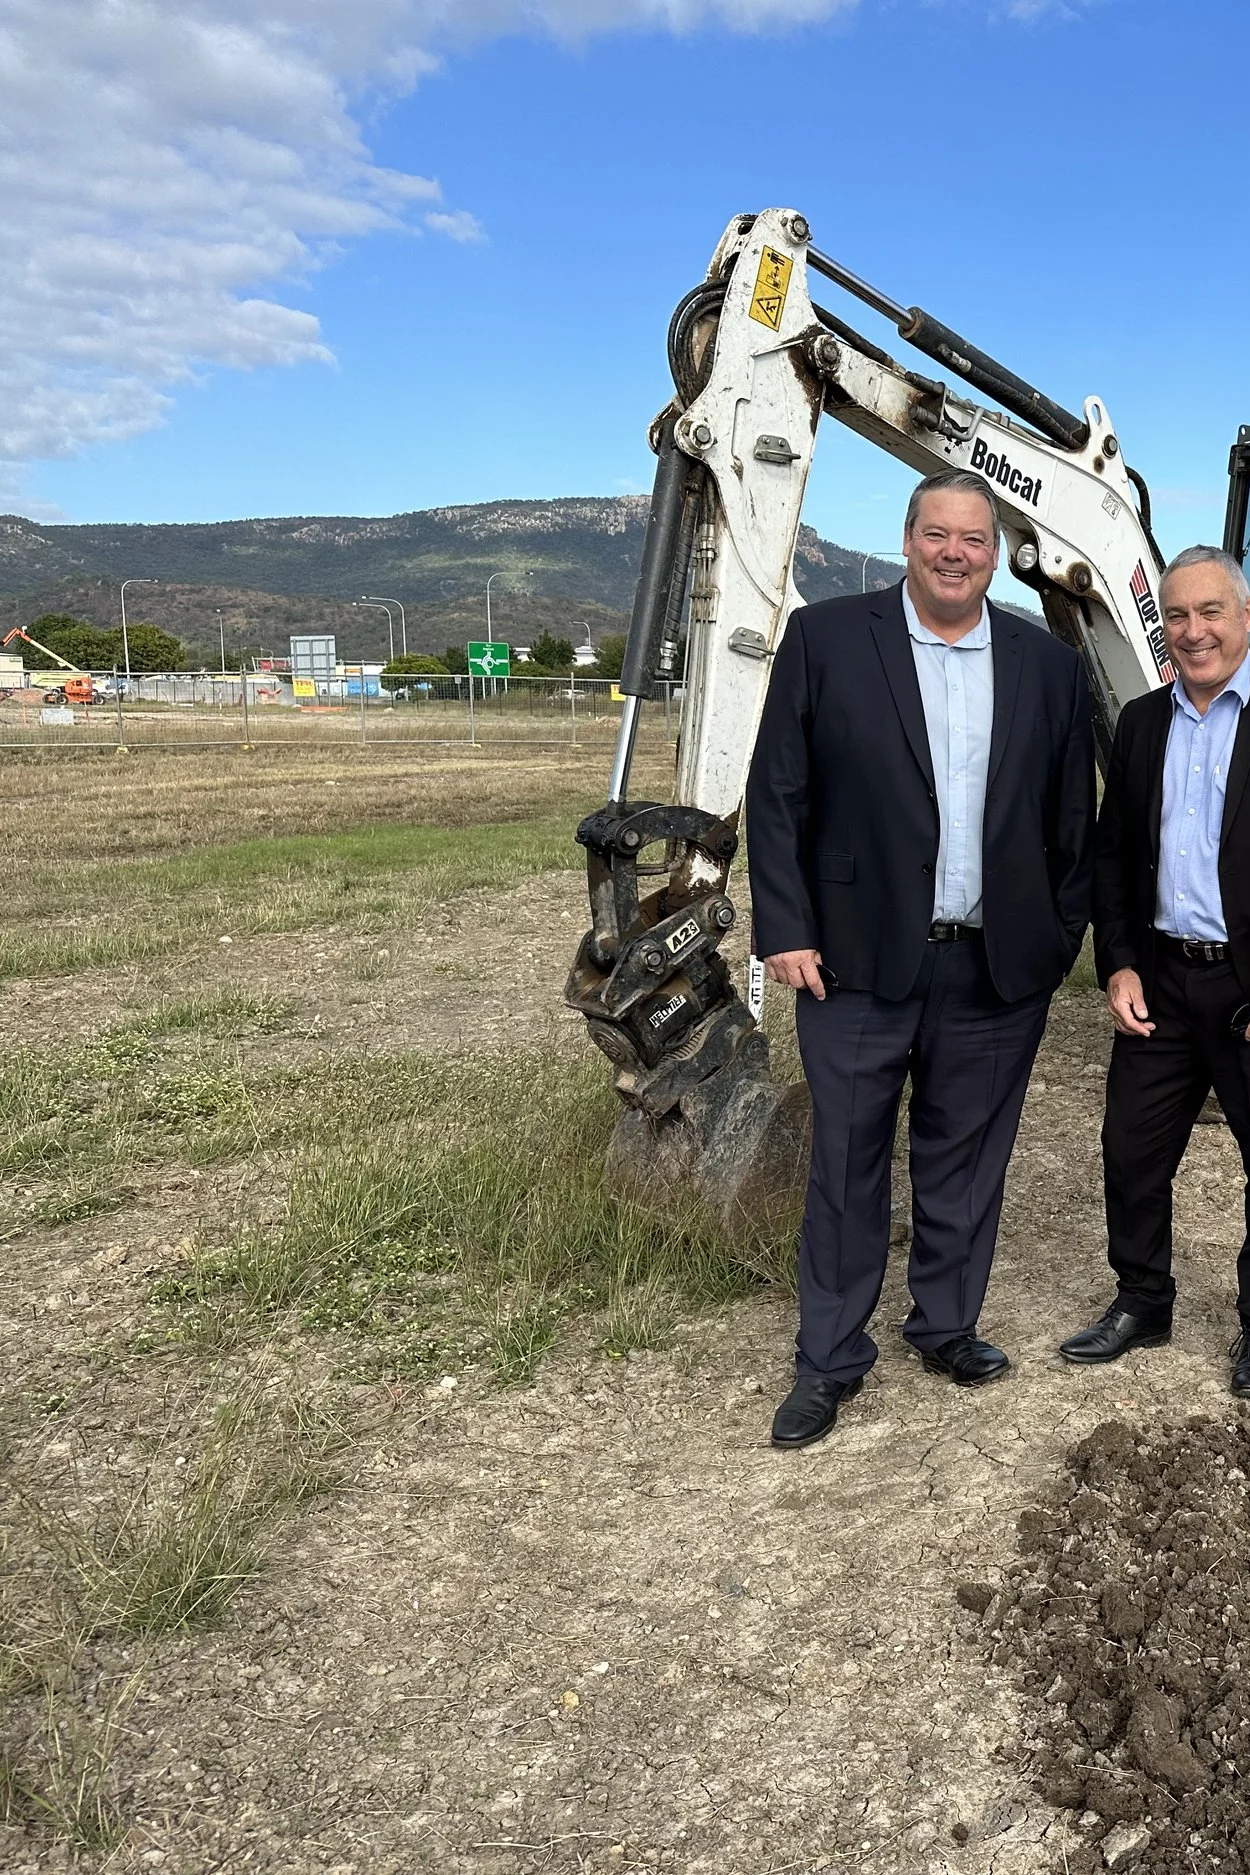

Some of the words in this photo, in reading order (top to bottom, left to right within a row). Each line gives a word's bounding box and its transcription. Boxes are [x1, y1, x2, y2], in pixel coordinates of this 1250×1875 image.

[970, 437, 1042, 507] Bobcat
[1138, 590, 1160, 624] TOP
[1149, 625, 1171, 667] GUN
